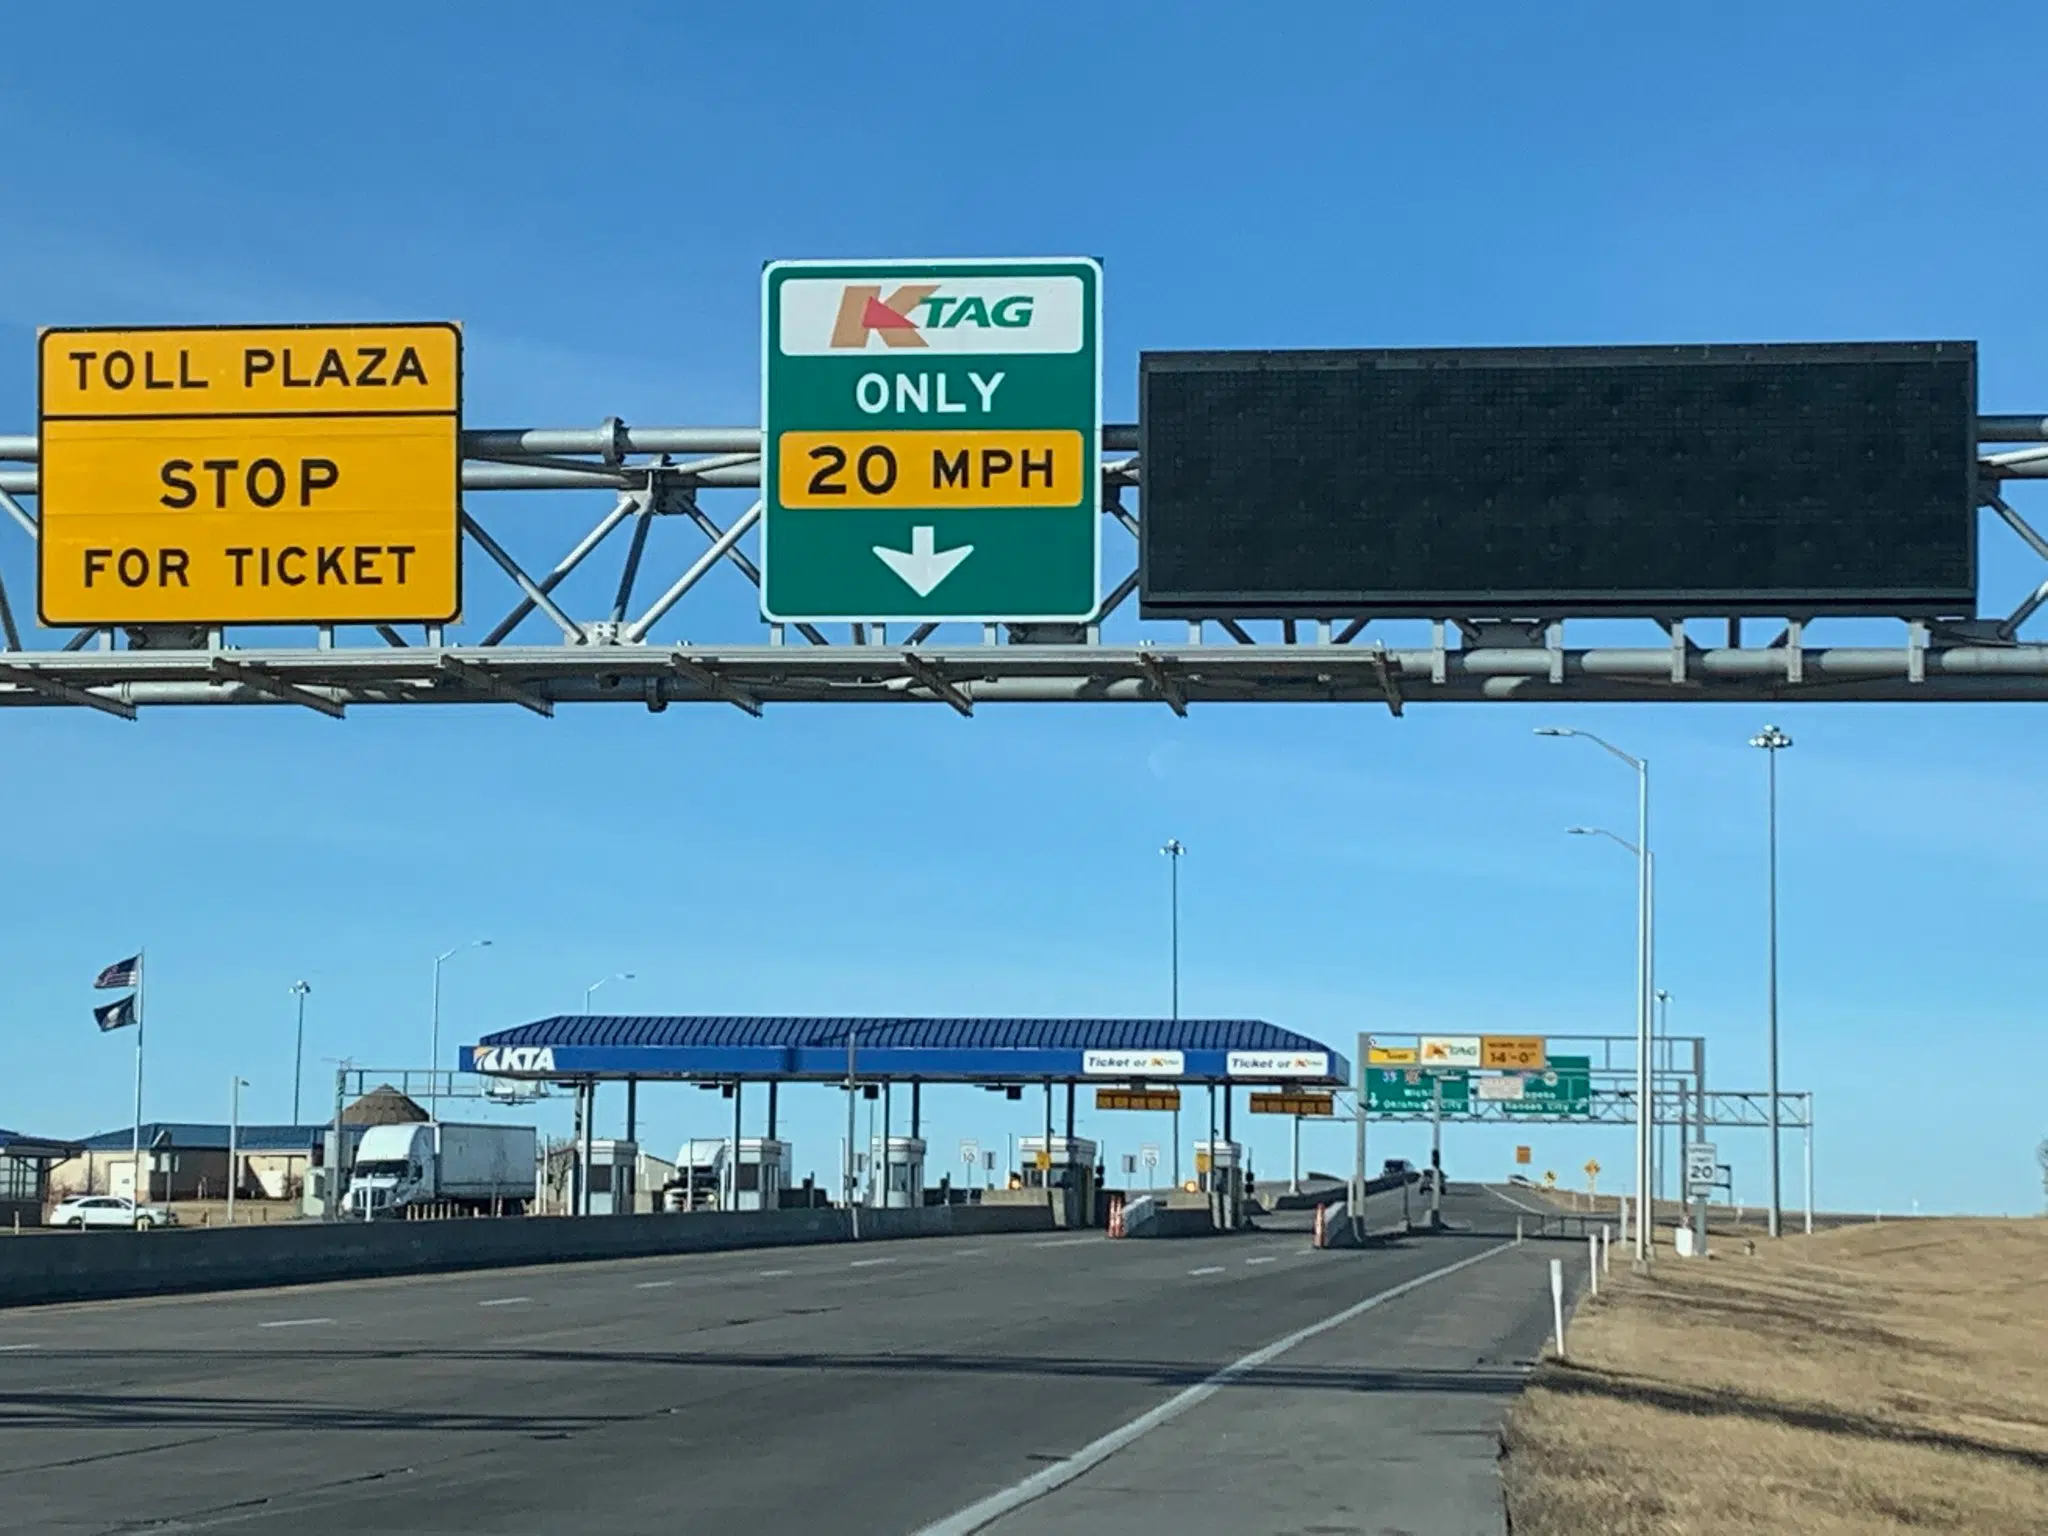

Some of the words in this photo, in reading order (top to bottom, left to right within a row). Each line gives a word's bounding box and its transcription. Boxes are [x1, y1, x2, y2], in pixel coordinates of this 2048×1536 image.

[69, 349, 209, 390] TOLL
[244, 346, 429, 388] PLAZA
[856, 371, 1006, 414] ONLY
[159, 458, 340, 509] STOP
[807, 445, 898, 496] 20
[932, 448, 1054, 490] MPH
[83, 547, 190, 588] FOR
[225, 545, 416, 586] TICKET
[1088, 1057, 1130, 1068] Ticket
[1133, 1060, 1147, 1068] or
[1232, 1058, 1273, 1069] Ticket
[1277, 1061, 1290, 1069] or
[1690, 1165, 1713, 1179] 20
